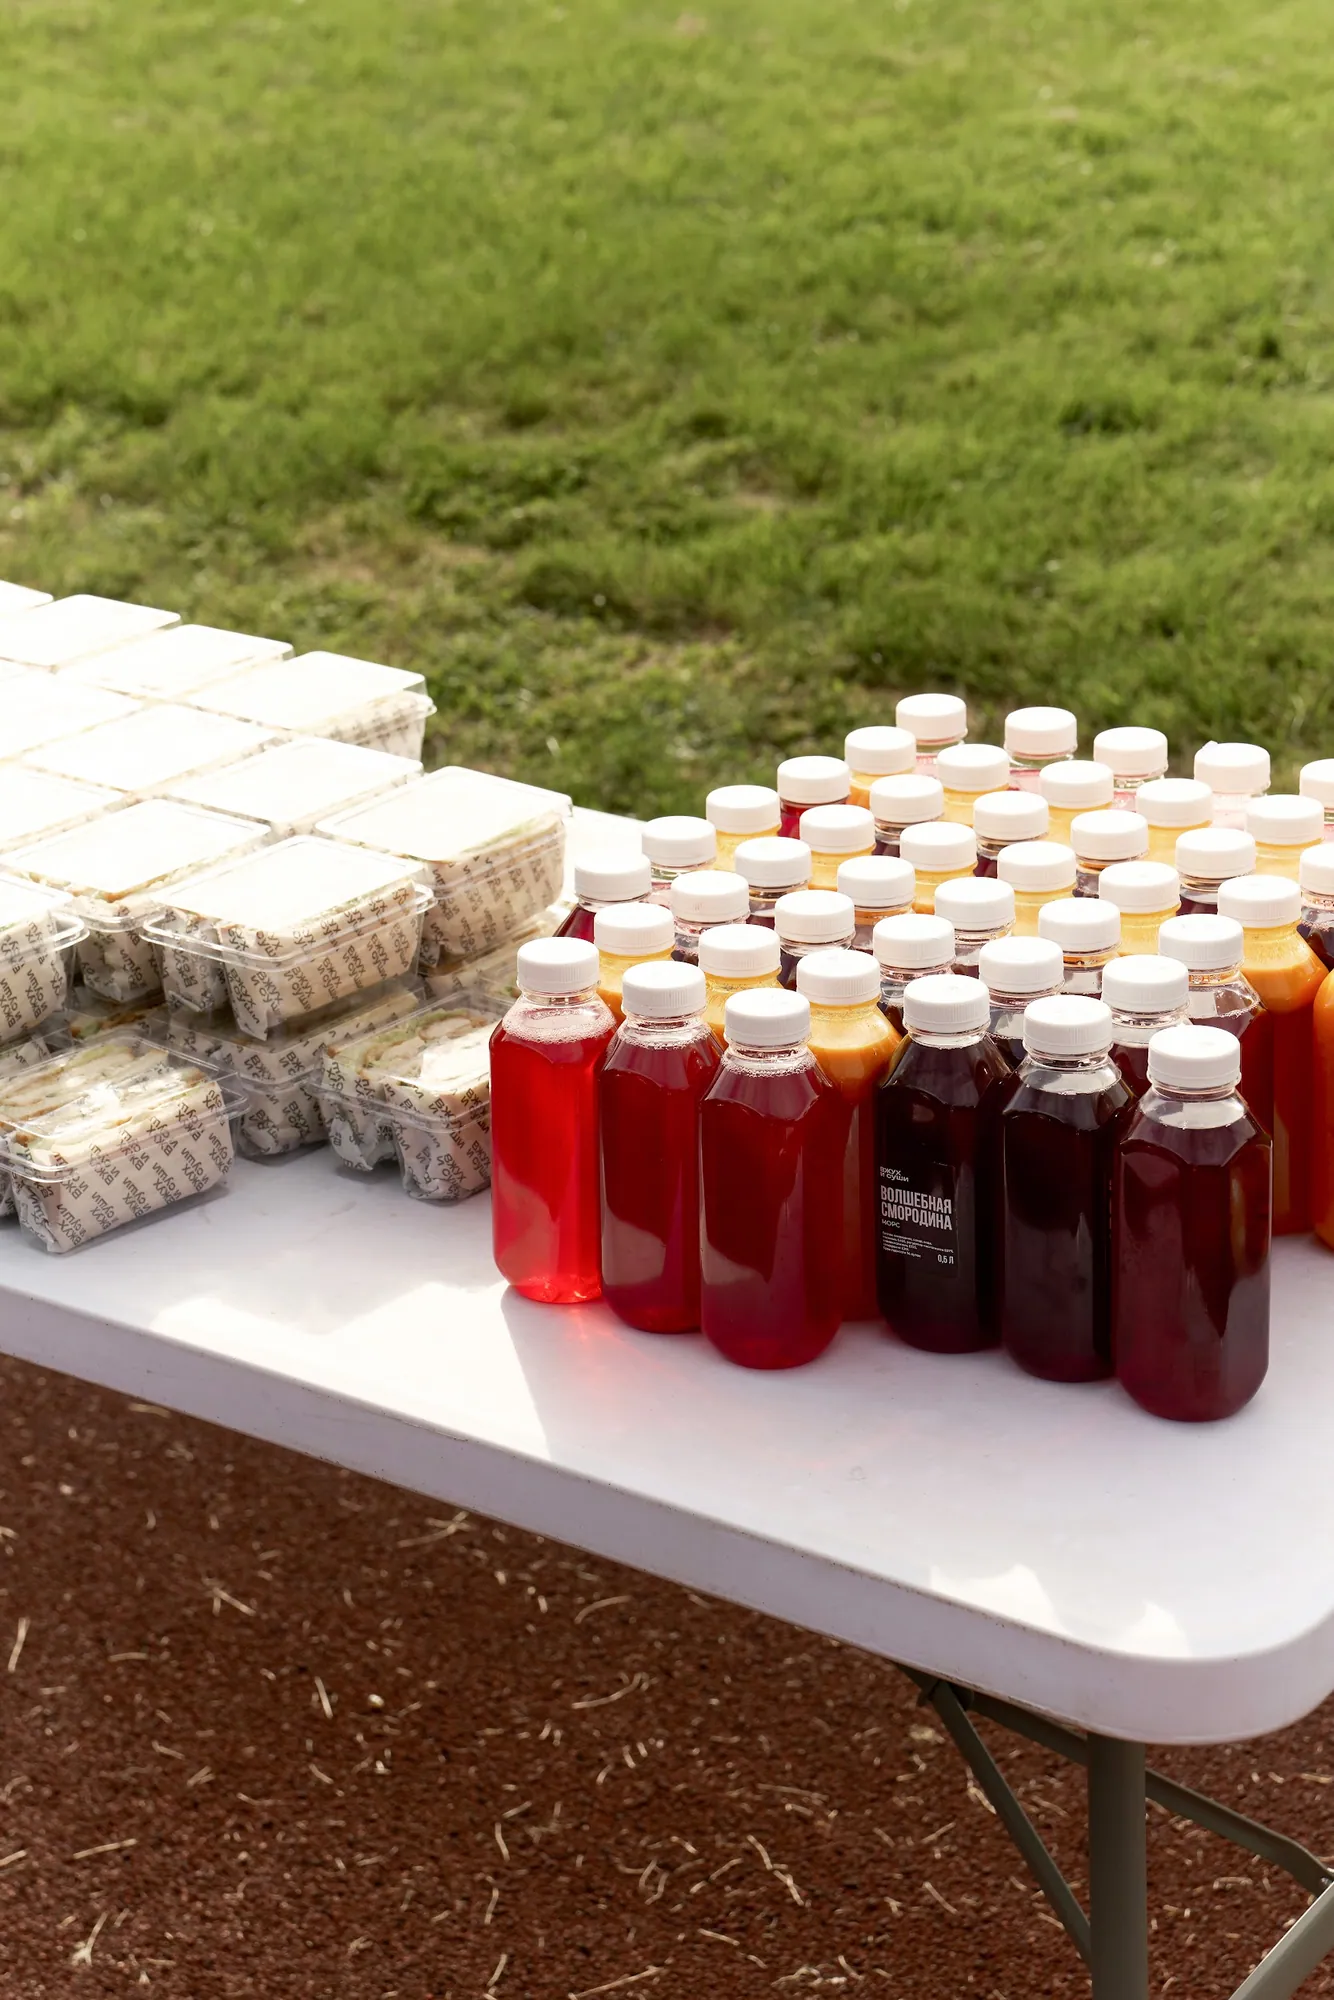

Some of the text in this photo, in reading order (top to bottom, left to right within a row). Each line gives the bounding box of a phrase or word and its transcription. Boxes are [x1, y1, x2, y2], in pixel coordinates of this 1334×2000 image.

[880, 1185, 952, 1214] ВОЛШЕБНАЯ
[881, 1201, 953, 1231] СМОРОДИНА
[937, 1254, 948, 1263] 0,5
